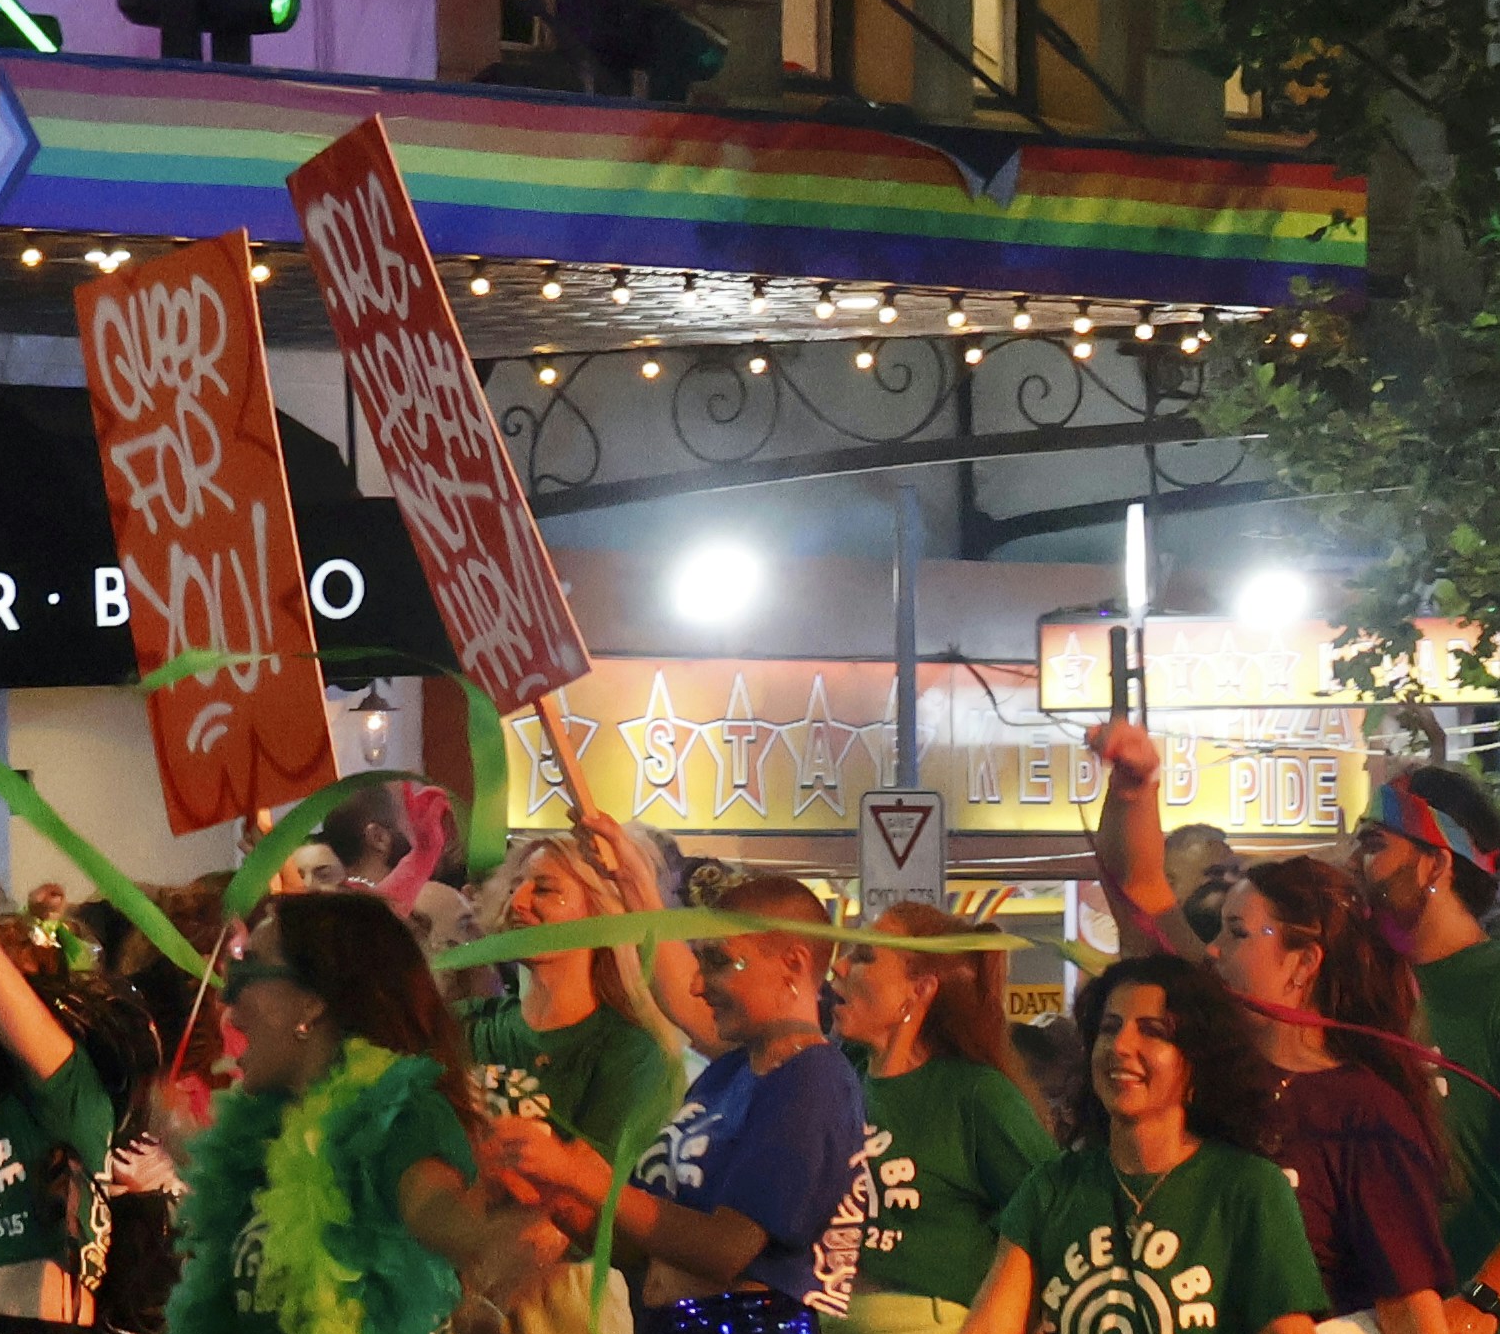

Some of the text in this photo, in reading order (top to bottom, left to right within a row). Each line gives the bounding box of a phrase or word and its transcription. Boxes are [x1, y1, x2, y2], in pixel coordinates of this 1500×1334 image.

[111, 402, 234, 534] FOR
[124, 502, 280, 694] YOU!
[967, 708, 1199, 806] KEBB
[1229, 756, 1340, 827] PIDE
[878, 1156, 921, 1211] BE
[1041, 1221, 1216, 1330] REE TO BE
